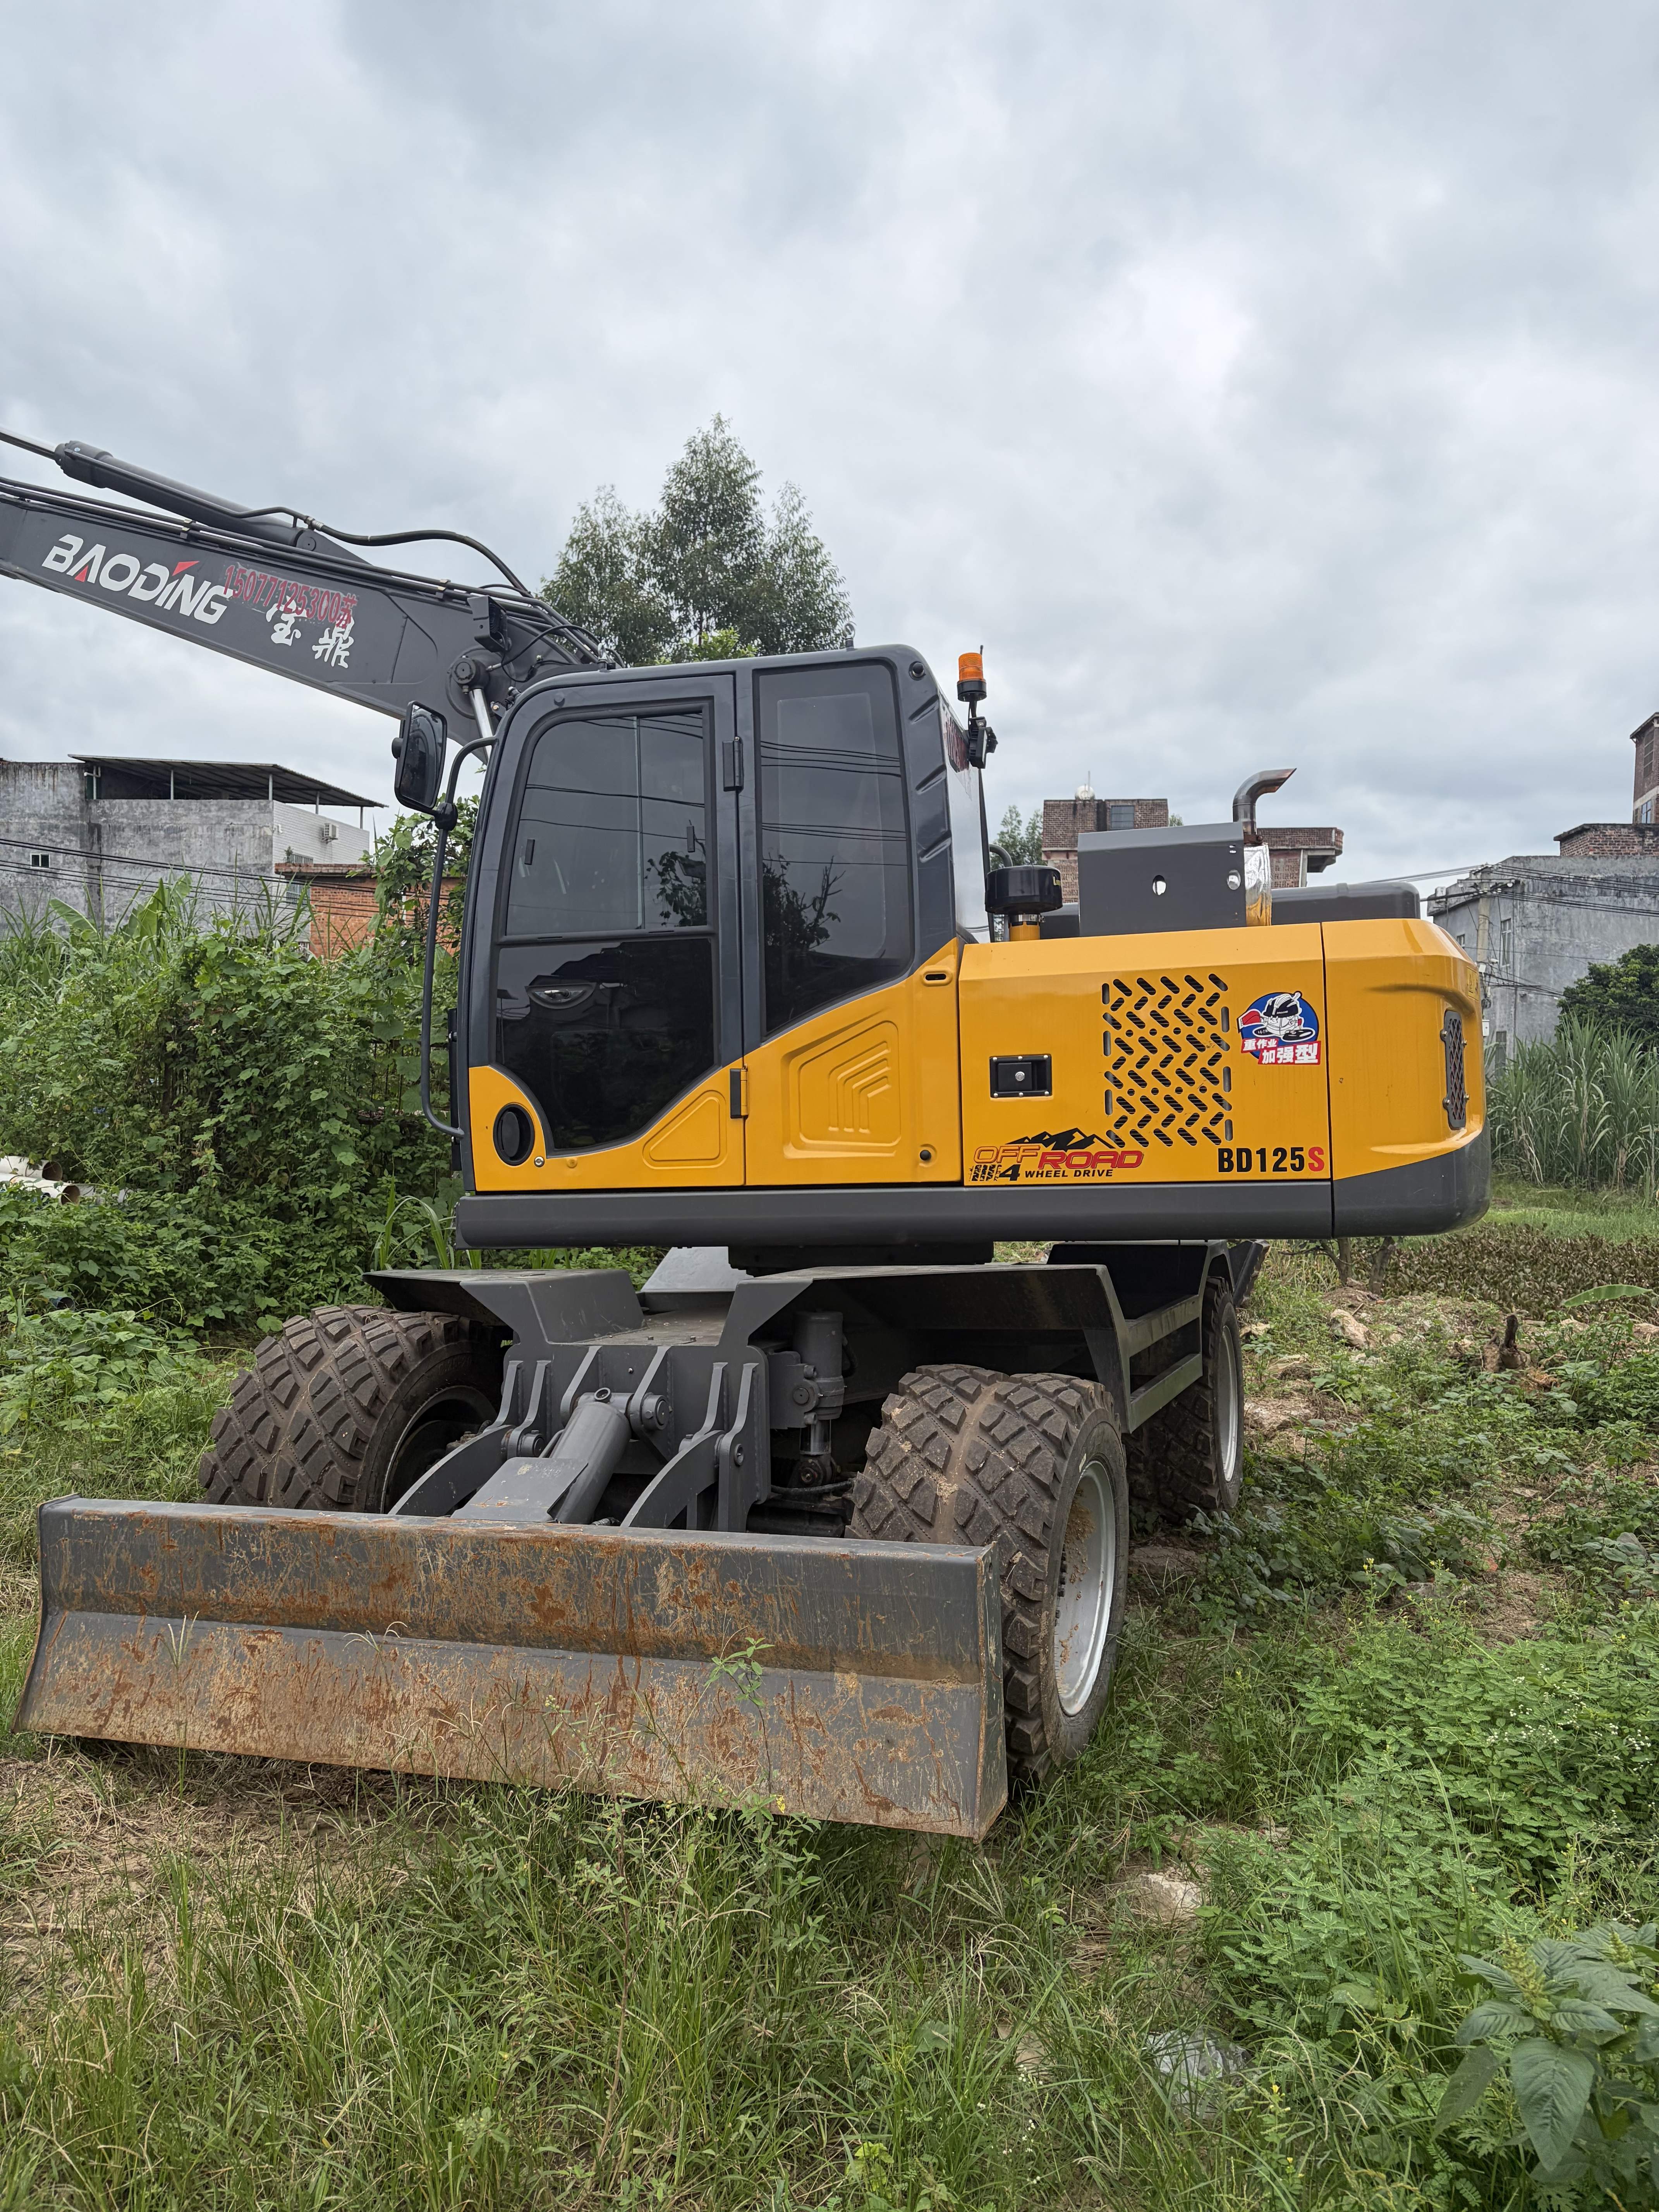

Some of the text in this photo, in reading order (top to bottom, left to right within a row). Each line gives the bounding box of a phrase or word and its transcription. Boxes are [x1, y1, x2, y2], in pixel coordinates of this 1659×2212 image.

[42, 534, 233, 624] BAODING
[1243, 1038, 1278, 1051] 重作业
[1262, 1042, 1318, 1064] 加强型
[974, 1145, 1144, 1170] OFF ROAD
[1218, 1146, 1325, 1173] BD125S
[999, 1164, 1113, 1181] 4 WHEEL DRIVE
